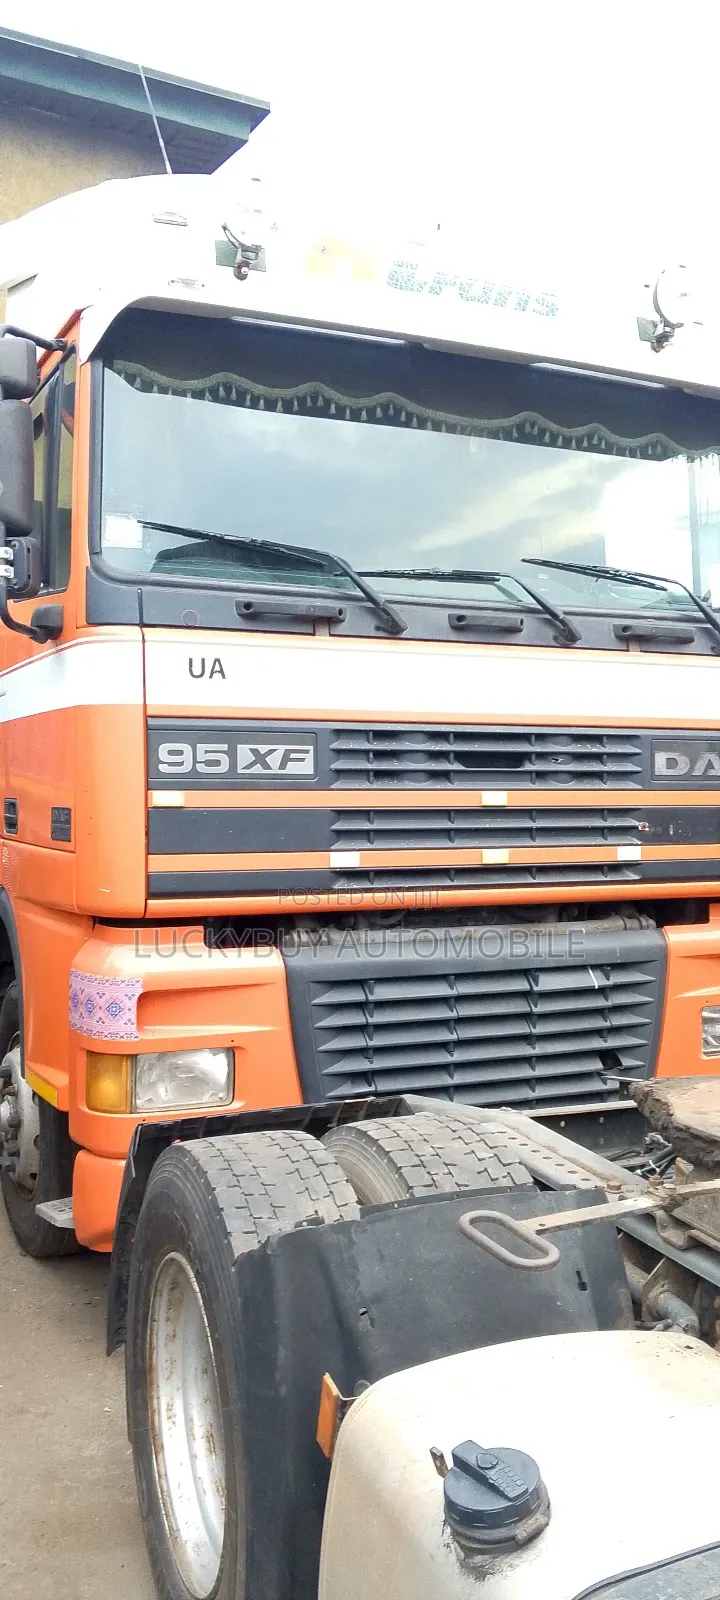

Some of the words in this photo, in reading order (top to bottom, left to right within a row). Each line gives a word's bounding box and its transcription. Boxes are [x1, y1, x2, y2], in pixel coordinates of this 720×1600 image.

[188, 657, 227, 680] UA
[158, 743, 230, 774] 95
[240, 747, 312, 771] XF
